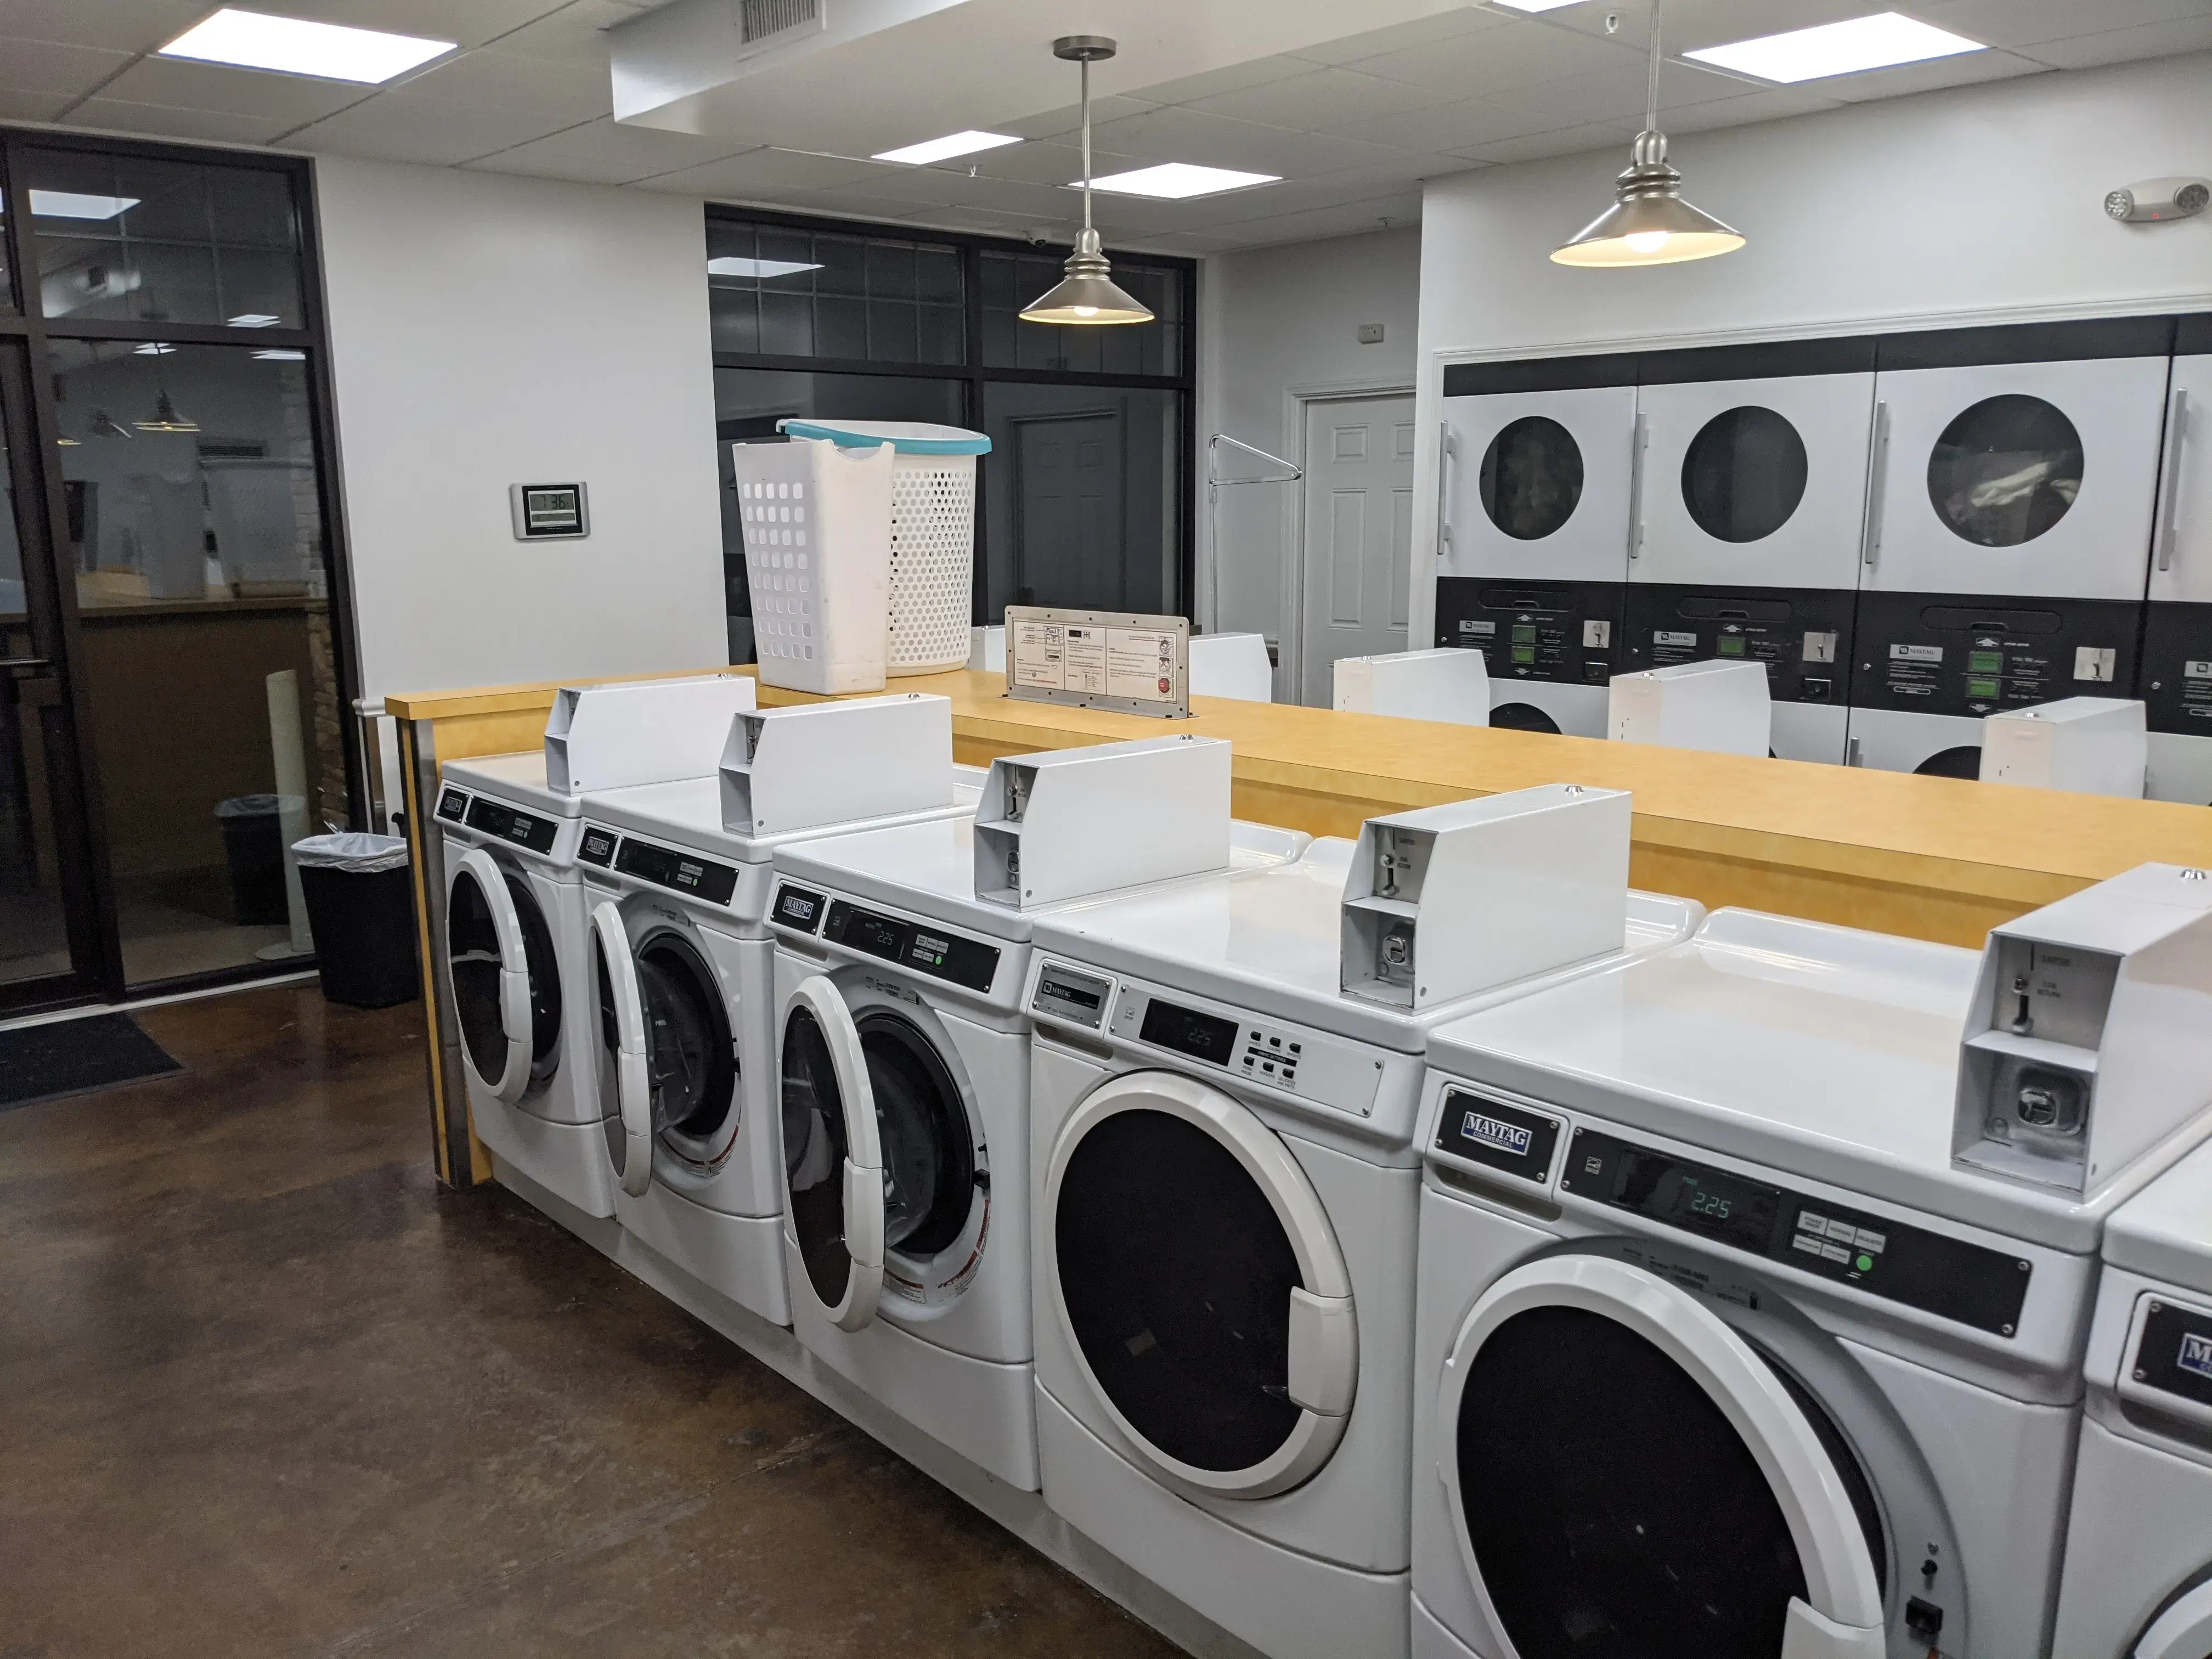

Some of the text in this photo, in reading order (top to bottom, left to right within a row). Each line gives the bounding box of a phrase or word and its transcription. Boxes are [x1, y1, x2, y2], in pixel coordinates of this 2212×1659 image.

[786, 898, 811, 913] MAYTAG
[1466, 1115, 1526, 1146] MAYTAG
[1473, 1131, 1513, 1148] COMMERCIAL
[1692, 1192, 1731, 1218] 2.25
